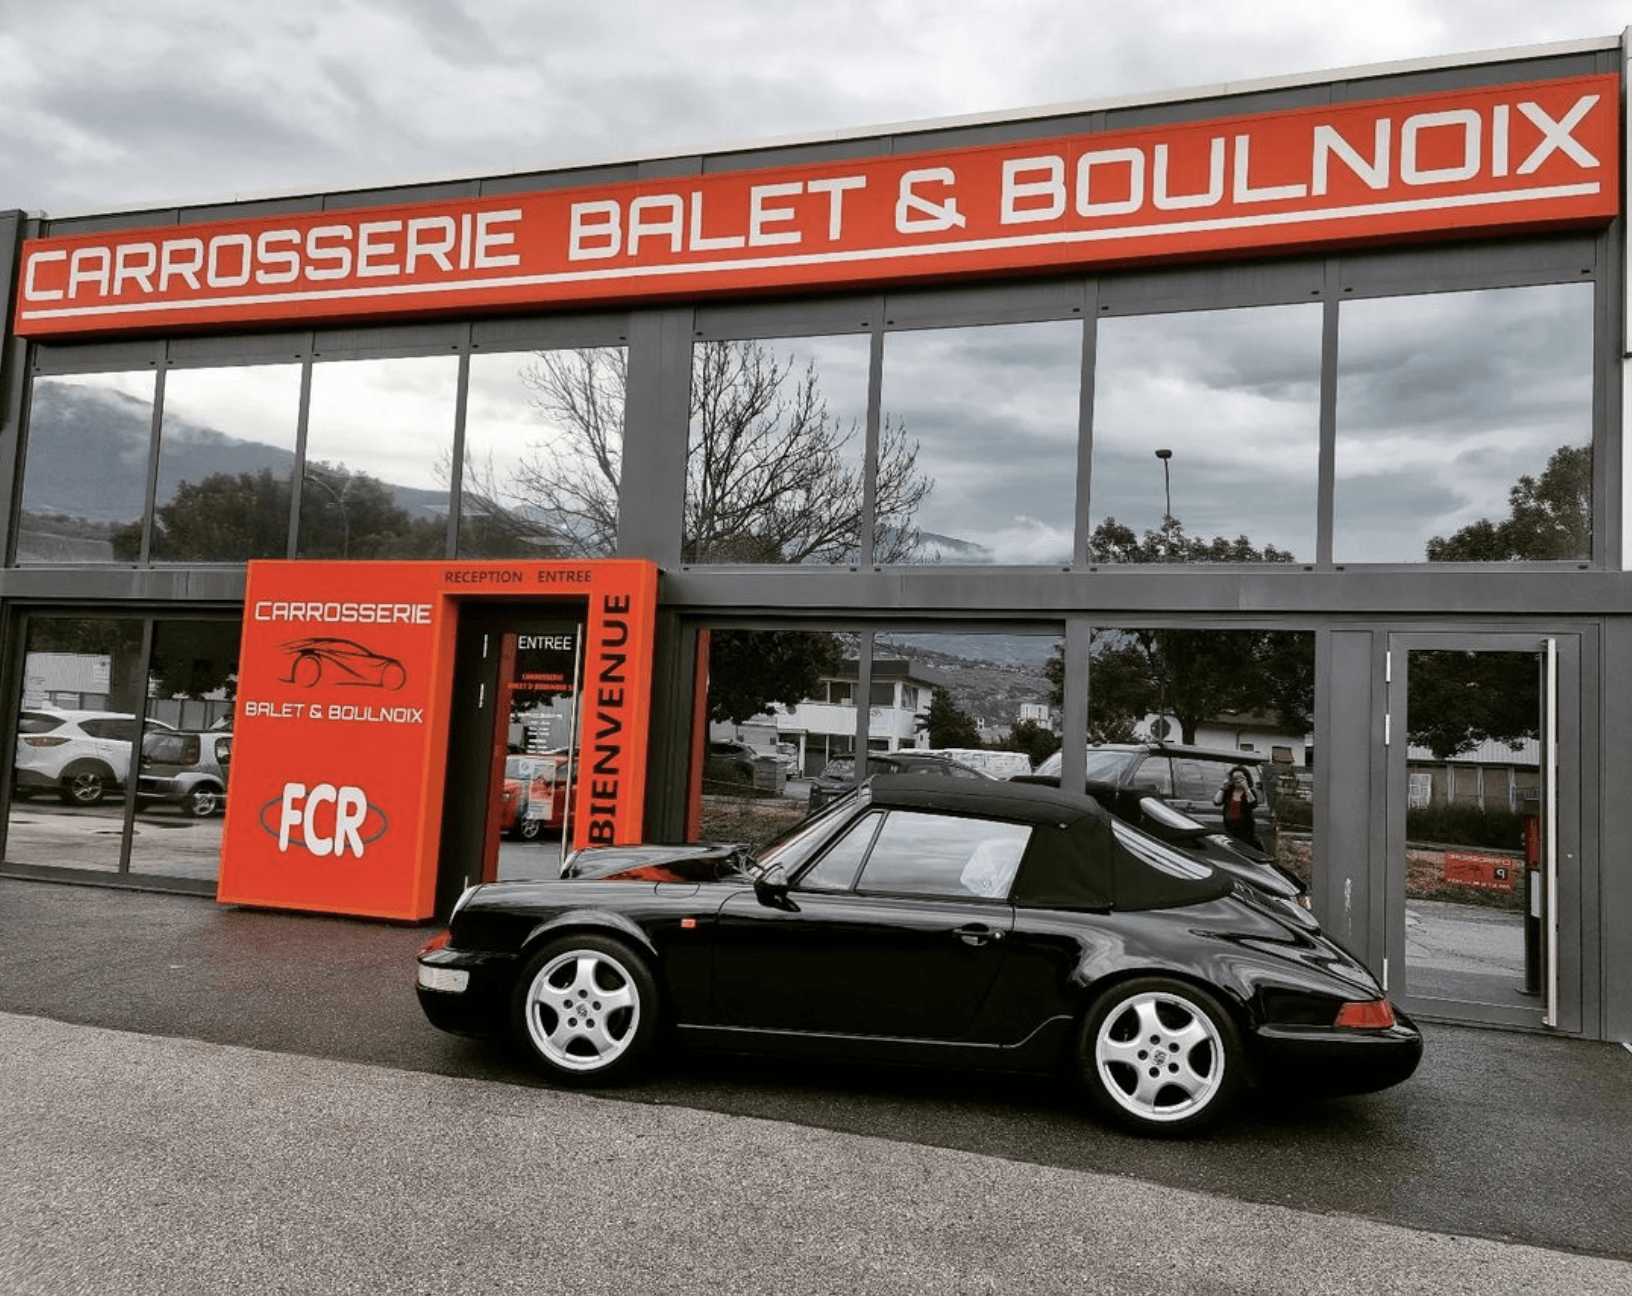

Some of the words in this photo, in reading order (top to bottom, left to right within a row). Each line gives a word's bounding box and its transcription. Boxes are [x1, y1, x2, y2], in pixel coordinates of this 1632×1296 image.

[24, 209, 523, 302] CARROSSERIE
[568, 175, 867, 261] BALET
[895, 167, 966, 234] &
[1000, 94, 1601, 225] BOULNOIX
[445, 570, 523, 583] RECEPTION
[538, 570, 592, 583] ENTREE
[255, 601, 432, 624] CARROSSERIE
[518, 636, 572, 650] ENTREE
[245, 701, 305, 717] BALET
[309, 704, 322, 719] &
[328, 705, 423, 723] BOULNOIX
[588, 594, 630, 844] BIENVENUE
[278, 782, 368, 858] FCR
